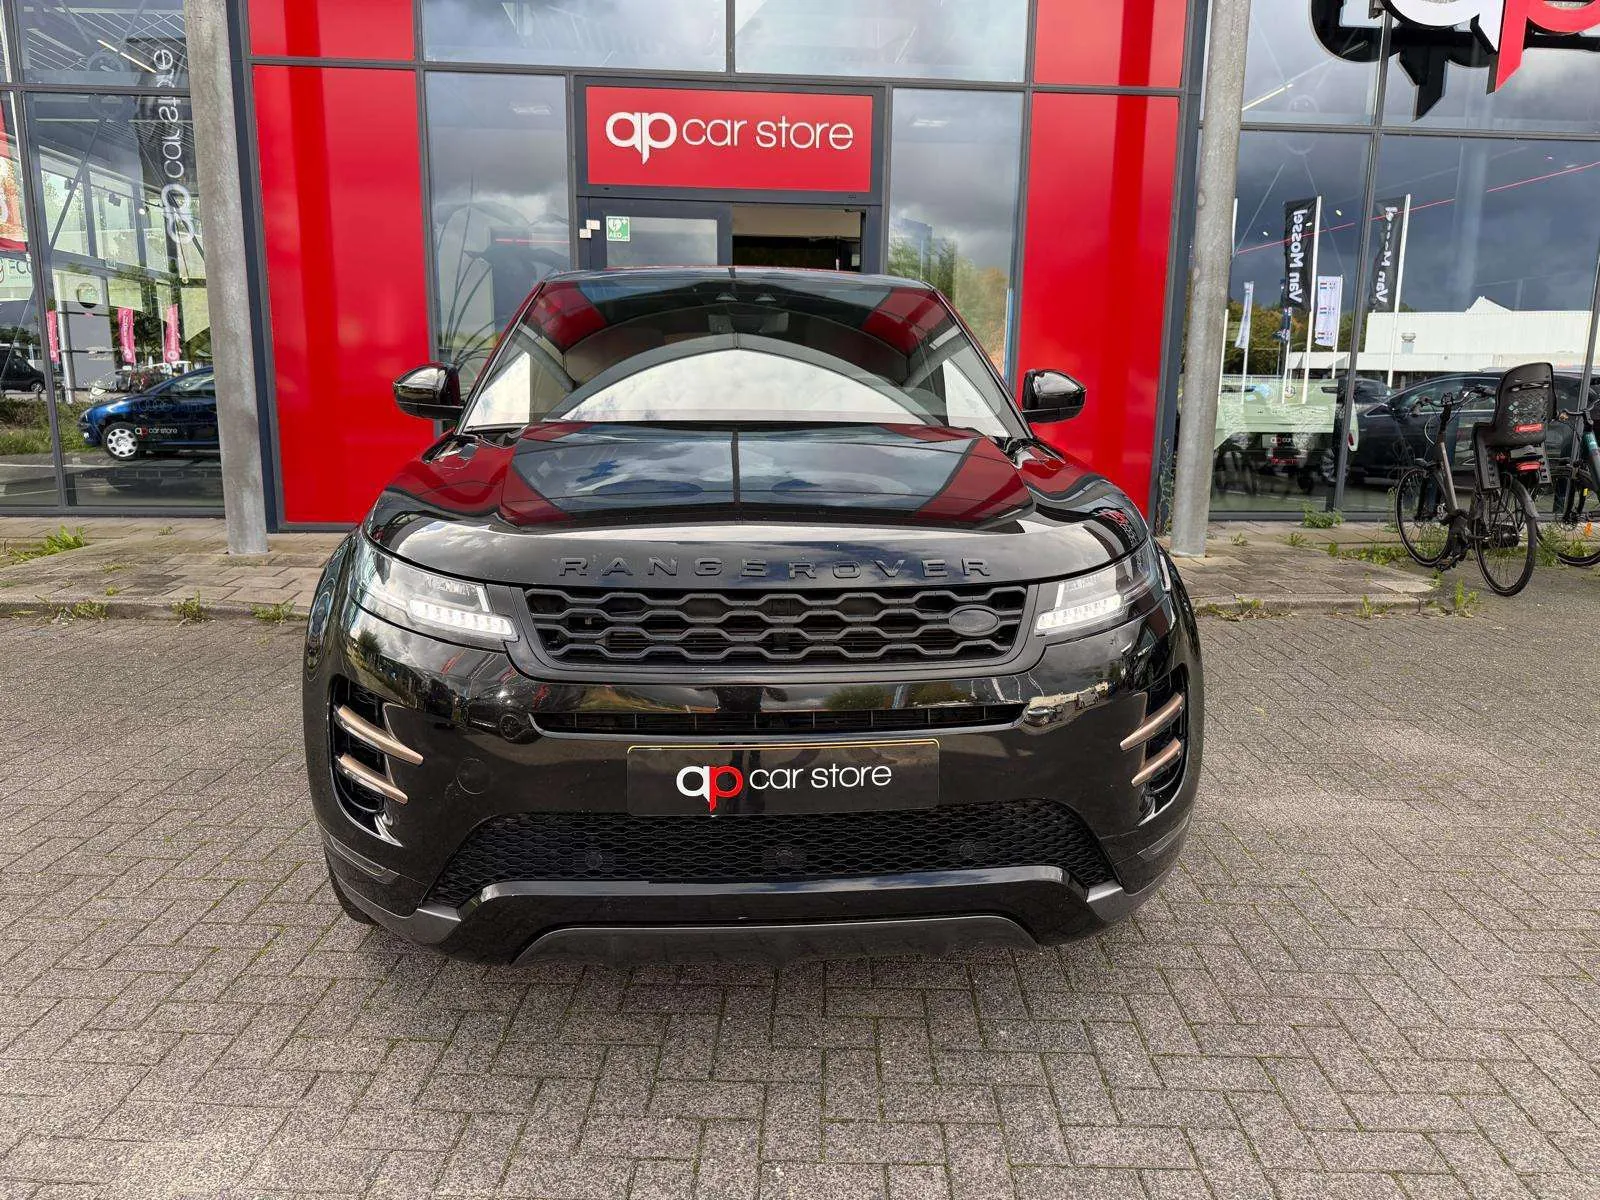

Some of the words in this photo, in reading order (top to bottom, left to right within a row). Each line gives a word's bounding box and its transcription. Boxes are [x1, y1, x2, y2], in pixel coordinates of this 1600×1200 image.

[605, 112, 678, 166] ap
[682, 118, 748, 147] car
[755, 115, 854, 150] store
[558, 556, 768, 577] RANGE
[788, 557, 991, 579] ROVER
[676, 765, 744, 812] ap
[749, 768, 804, 790] car
[810, 763, 892, 789] store
